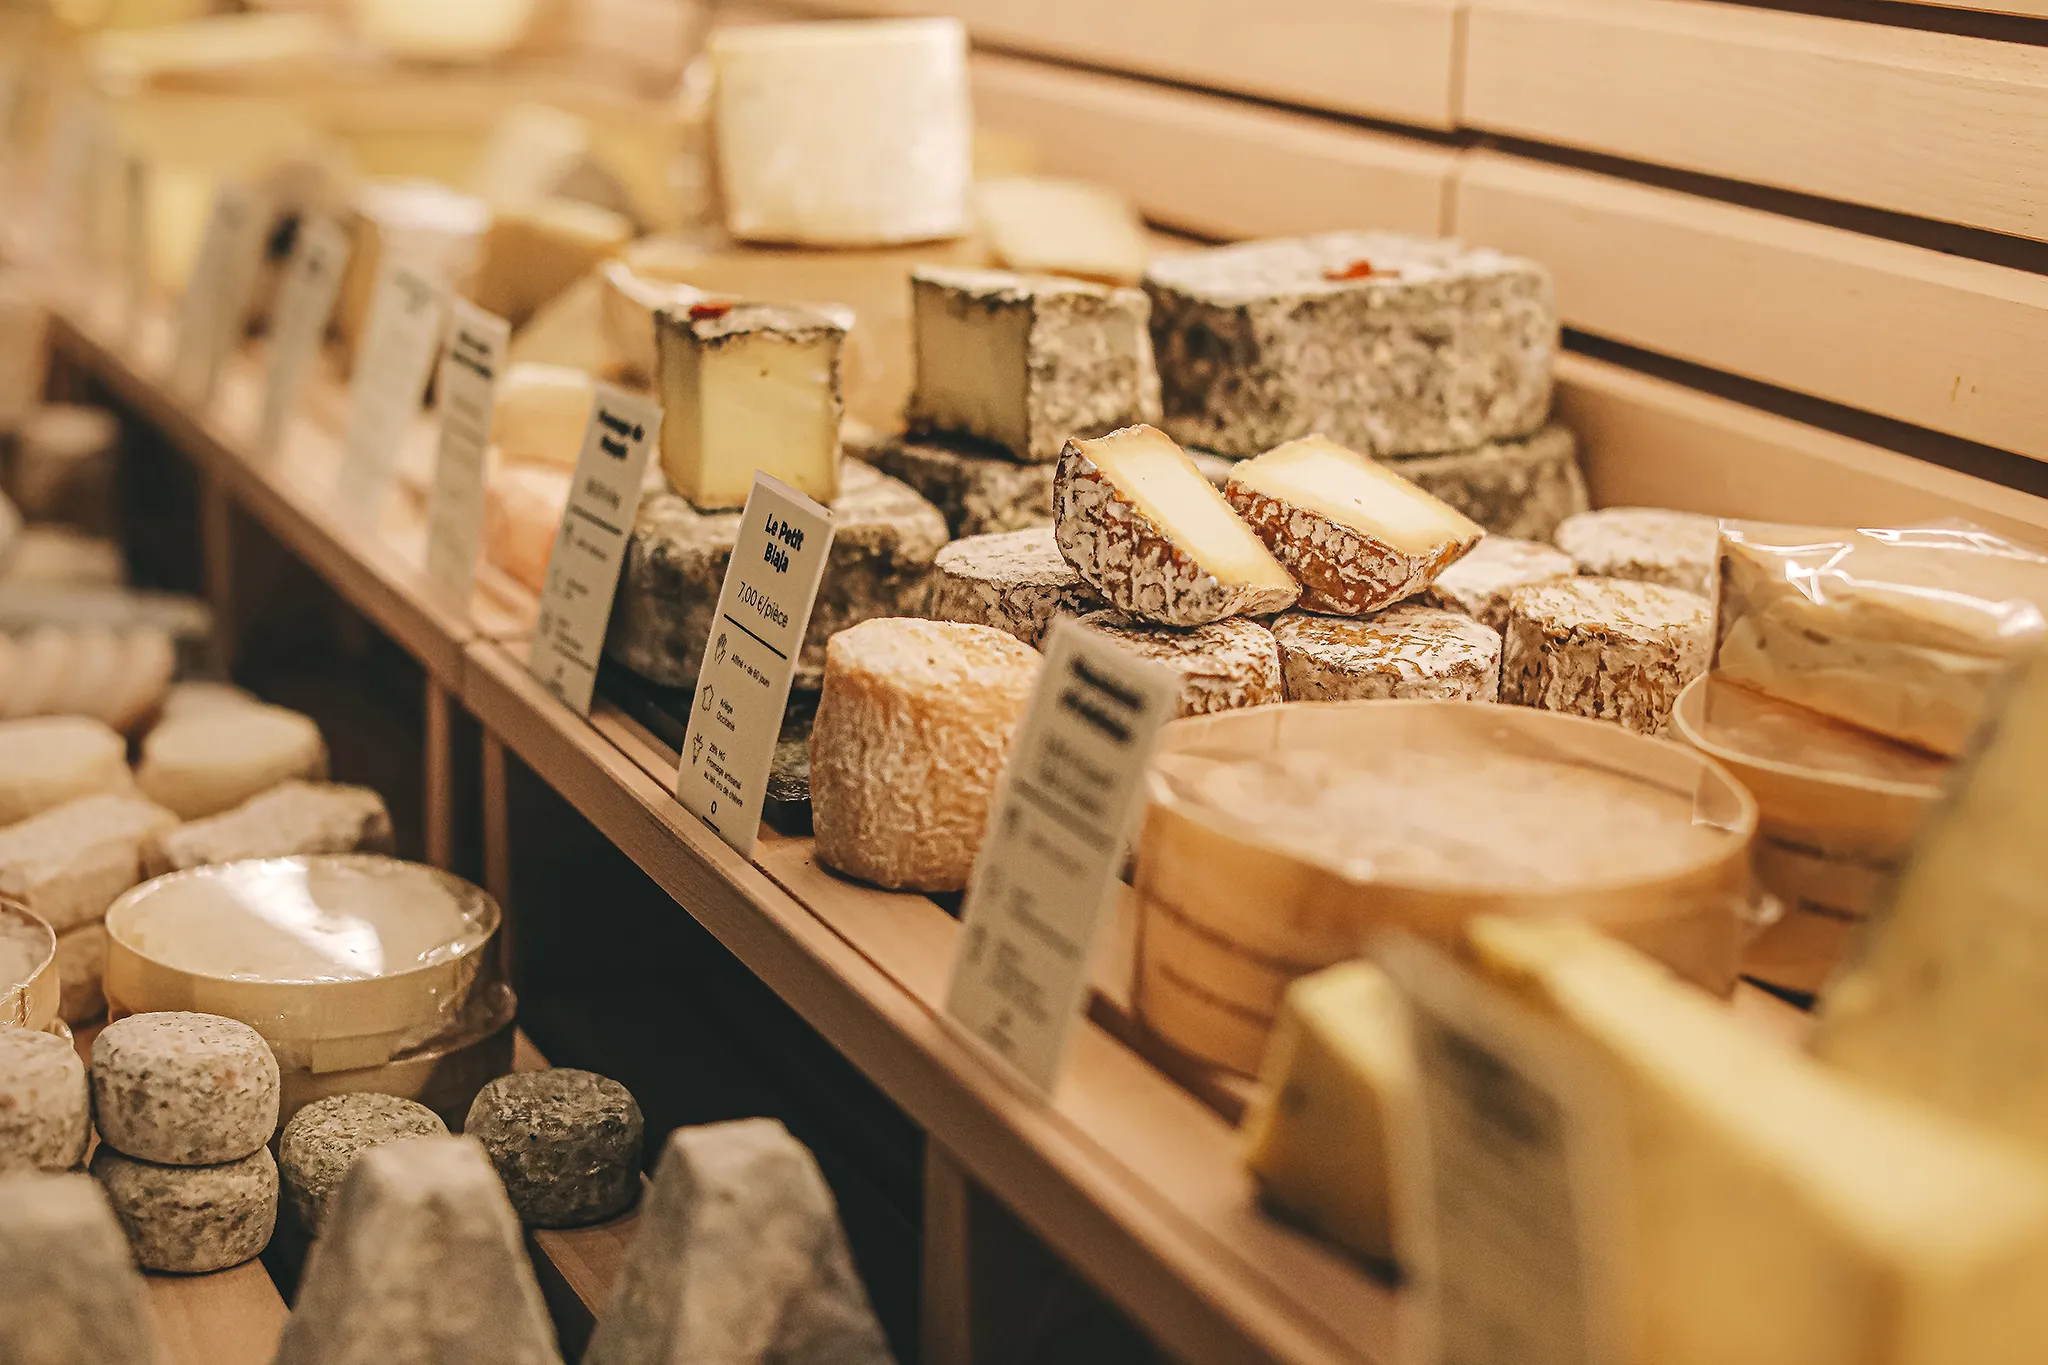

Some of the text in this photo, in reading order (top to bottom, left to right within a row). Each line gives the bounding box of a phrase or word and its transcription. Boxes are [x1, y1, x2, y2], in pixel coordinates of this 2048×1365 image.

[765, 513, 804, 552] Le Petit
[738, 581, 758, 606] 7,00
